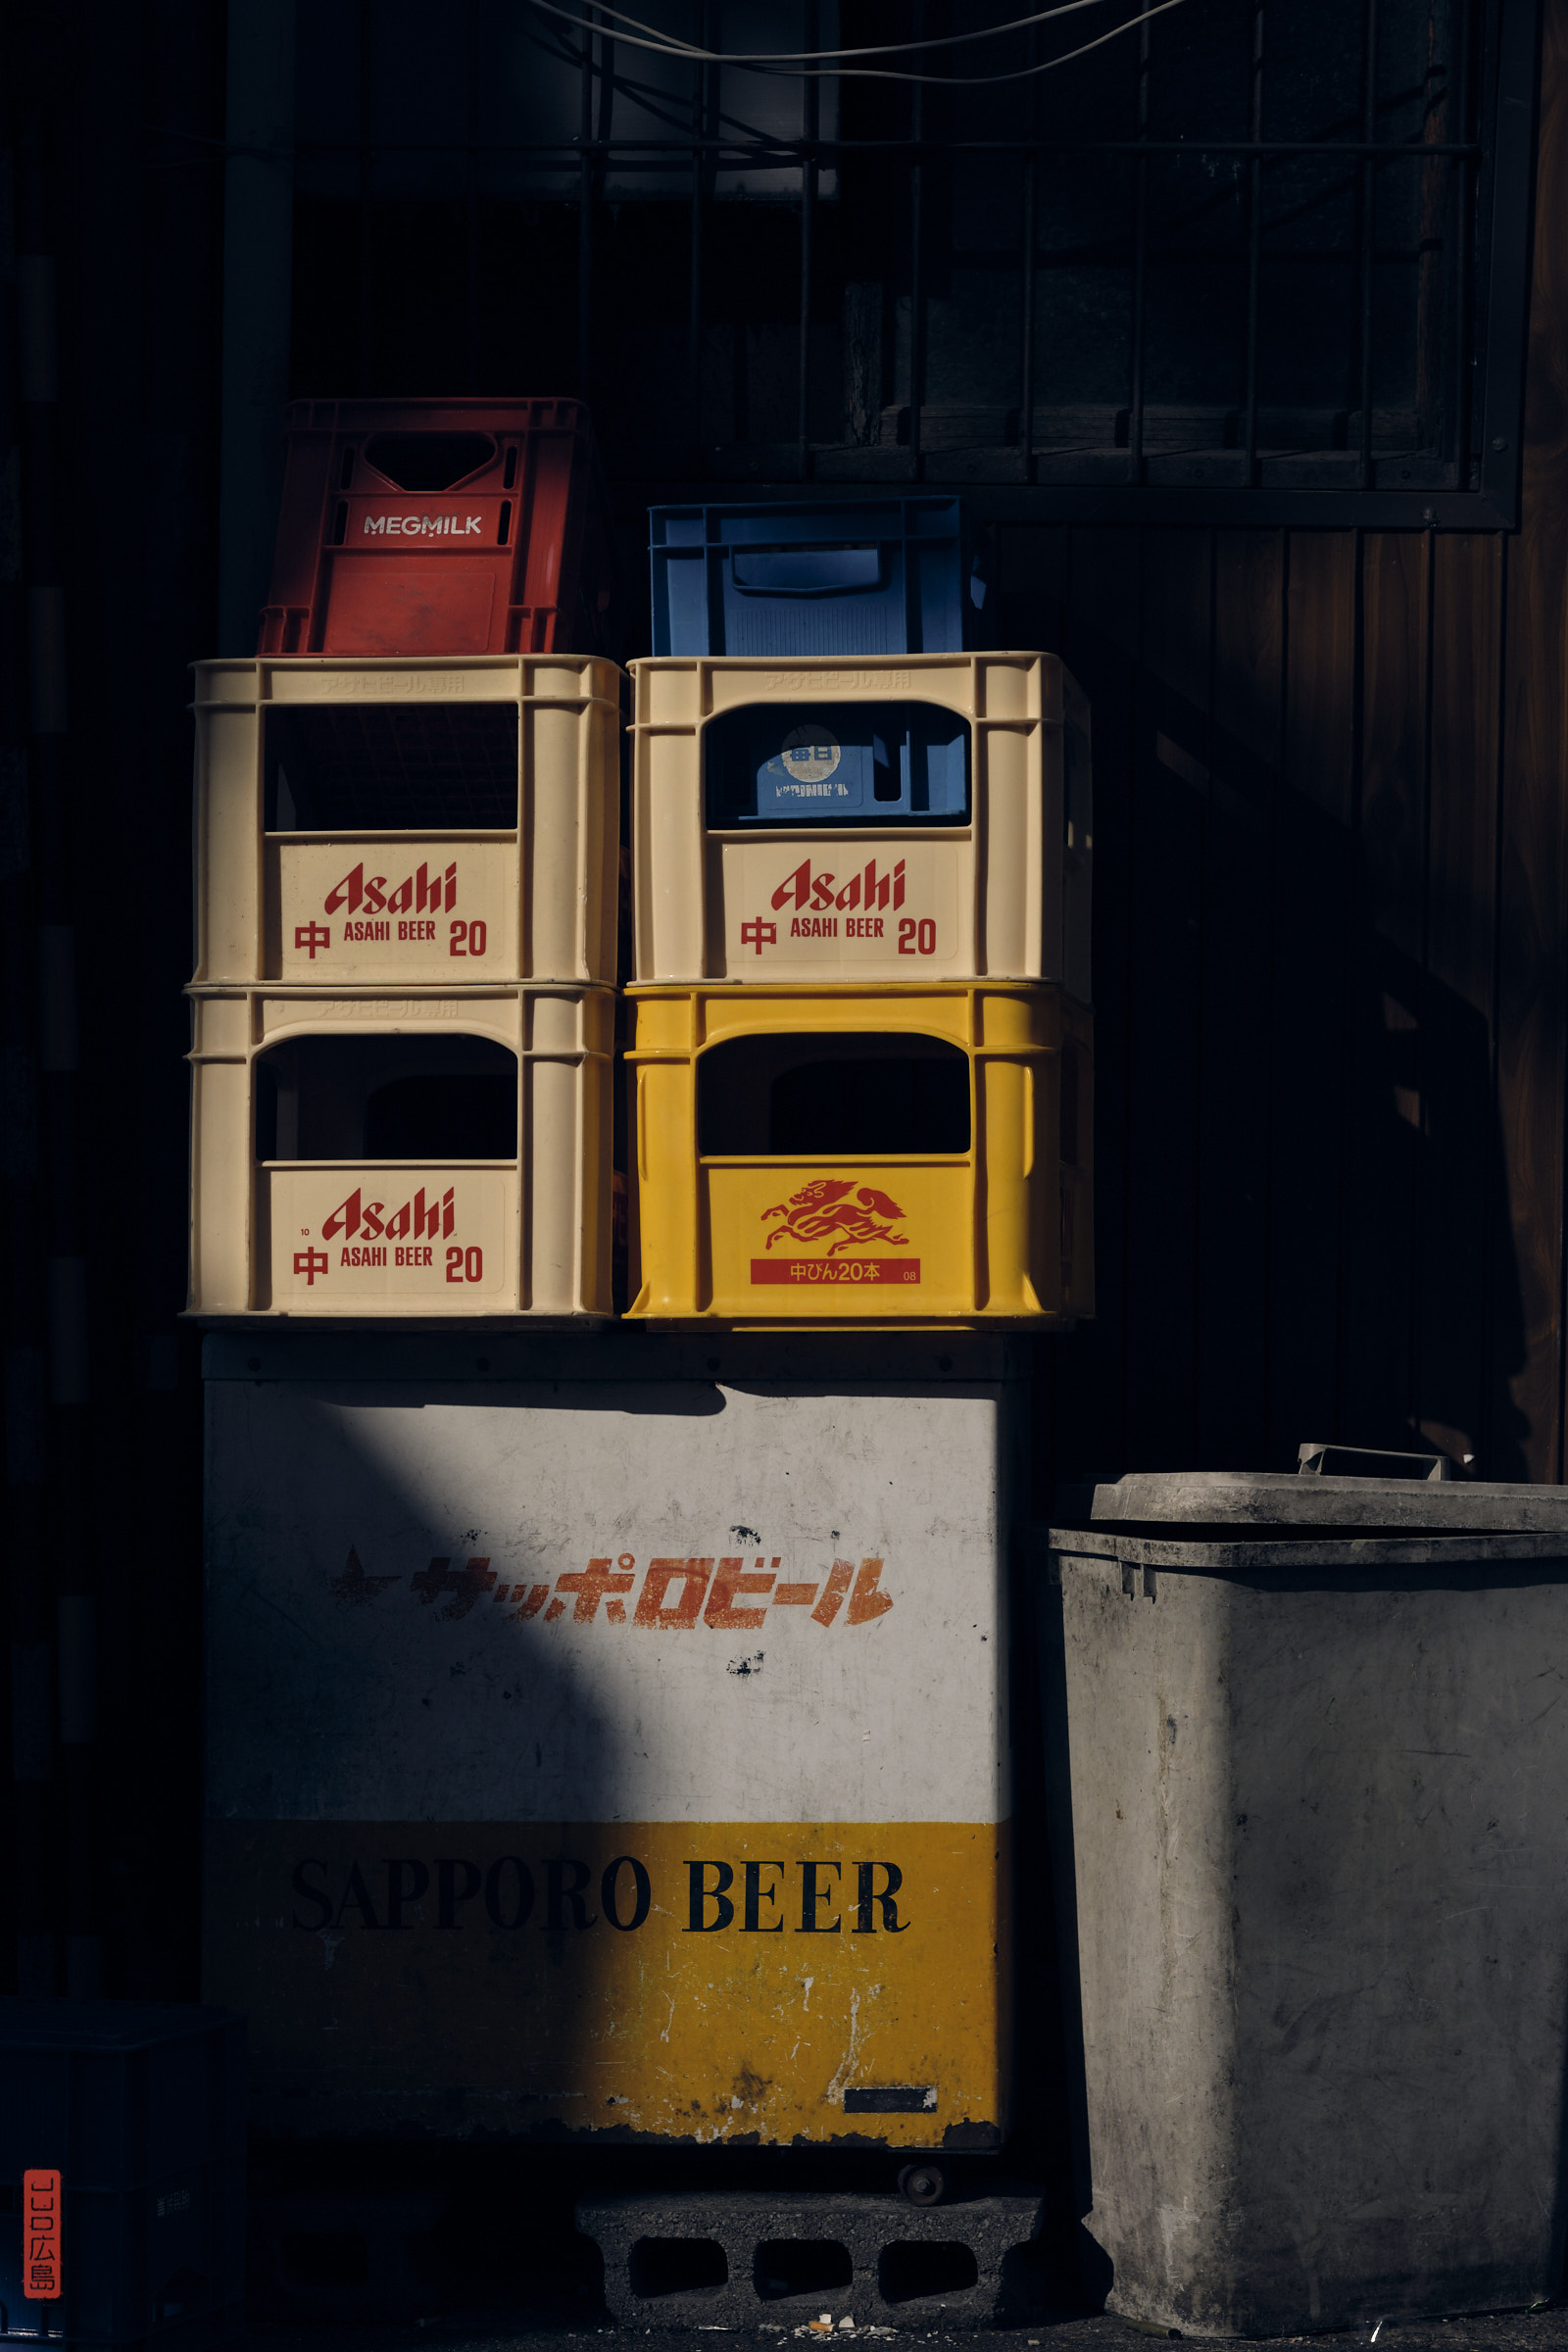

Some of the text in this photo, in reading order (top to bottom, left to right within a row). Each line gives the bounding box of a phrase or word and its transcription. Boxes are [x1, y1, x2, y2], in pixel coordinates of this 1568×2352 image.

[364, 515, 482, 538] MEGMILK
[324, 861, 457, 915] Asahi
[770, 858, 906, 911] Asahi
[295, 920, 487, 959] 中 ASAHI BEER 20
[741, 916, 936, 956] 中 ASAHI BEER 20
[300, 1228, 311, 1237] 10
[321, 1187, 455, 1241] Asahi
[293, 1246, 483, 1286] 中 ASAHI BEER 20
[790, 1262, 881, 1282] 中びん20本
[903, 1271, 917, 1282] 08
[411, 1552, 894, 1630] サッポロビール
[291, 1854, 911, 1934] SAPPORO BEER
